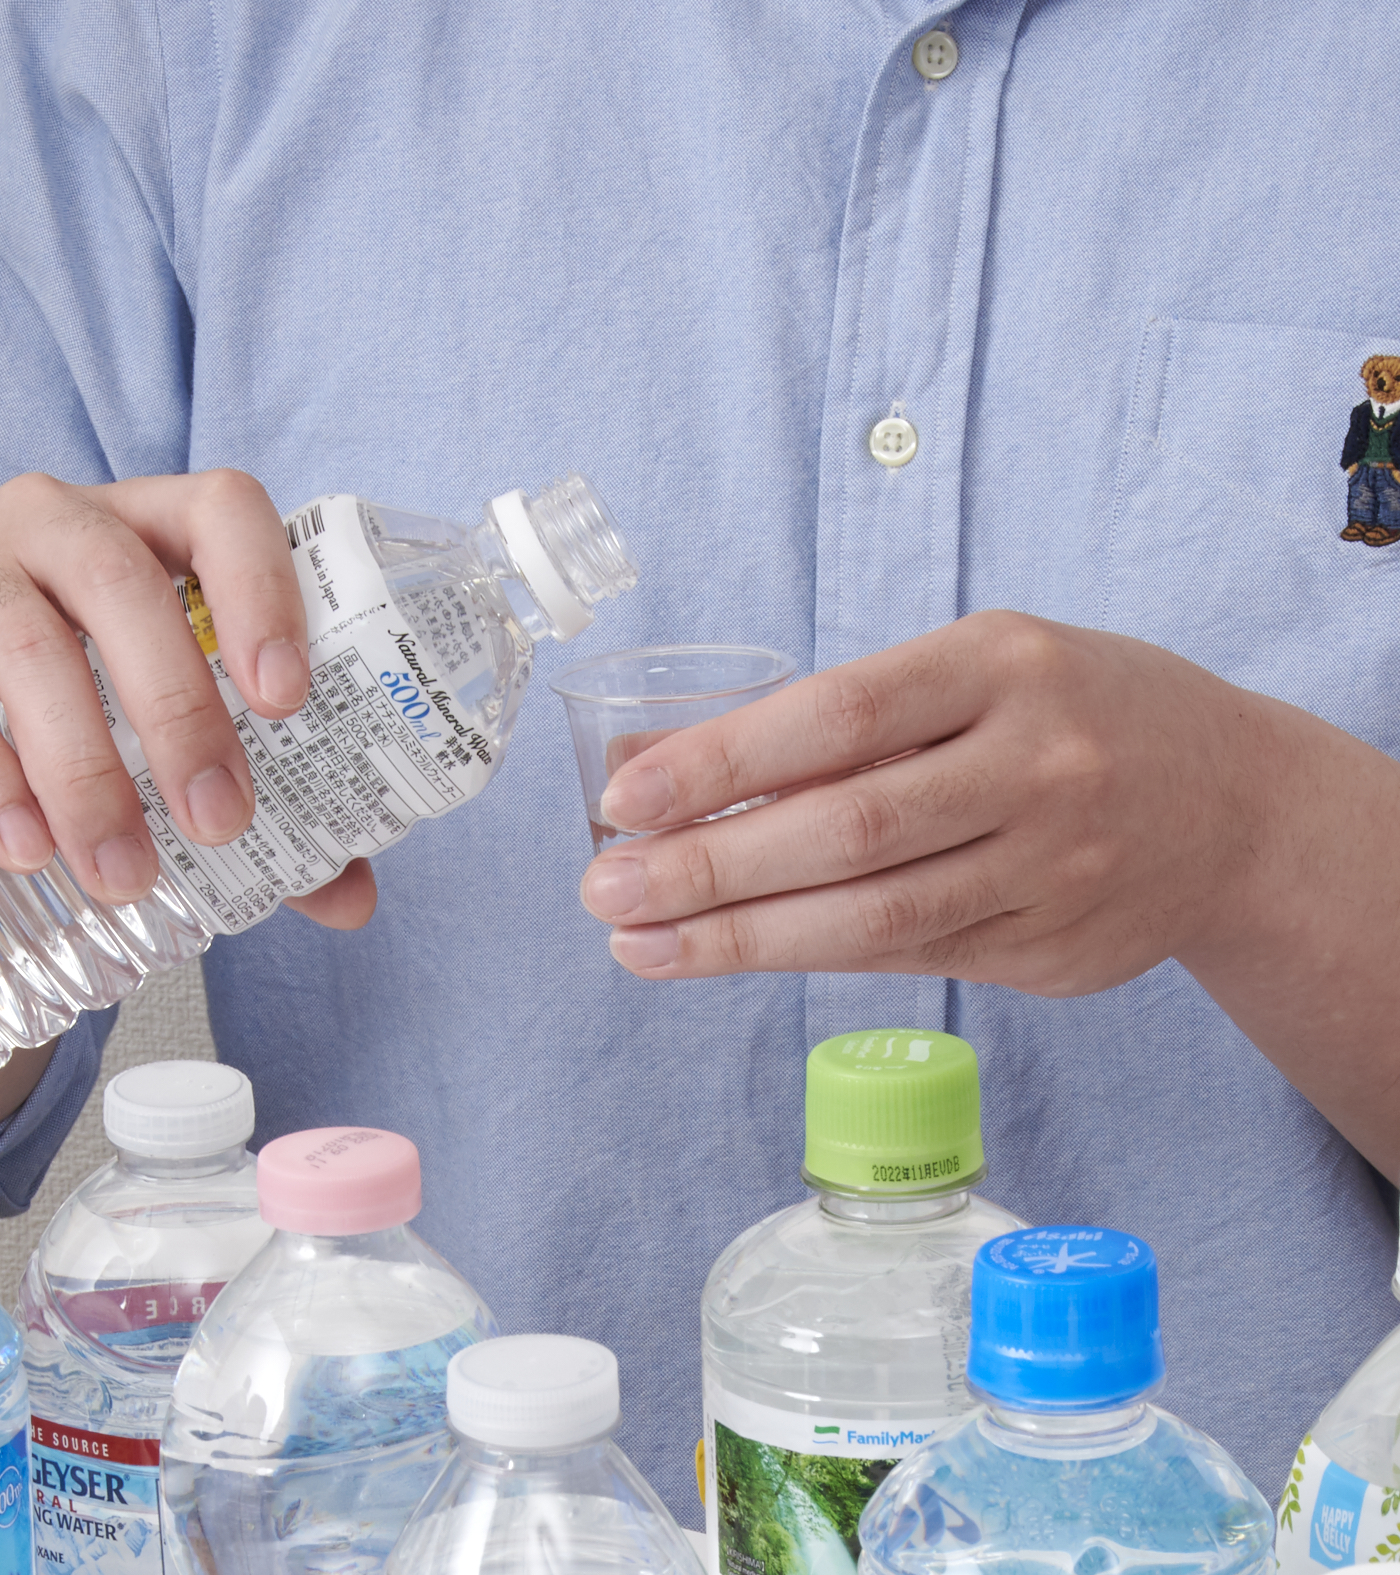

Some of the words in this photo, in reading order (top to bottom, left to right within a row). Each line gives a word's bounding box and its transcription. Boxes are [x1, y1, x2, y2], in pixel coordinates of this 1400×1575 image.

[306, 543, 326, 572] Made
[313, 565, 333, 583] in
[319, 578, 343, 612] Japan
[311, 669, 351, 715] 内容量
[325, 660, 366, 708] 原材料名
[359, 708, 395, 749] 水(鉱水)
[378, 666, 439, 742] 500ml
[389, 623, 438, 689] Natural
[426, 683, 473, 737] Mineral
[467, 729, 495, 766] Water
[330, 724, 391, 798] ボトル側面に記載
[373, 699, 458, 803] ナチュラルミネラルウォーター
[434, 747, 459, 773] 軟水
[443, 734, 473, 768] 非加熱
[231, 718, 271, 764] 採水地
[263, 763, 320, 832] 岐阜県関市洞戸
[289, 749, 363, 840] 奥長良川名水株式会社
[304, 741, 381, 836] 避けて保存してください。
[316, 733, 401, 837] 直射日光、高温多湿の場所を
[277, 755, 358, 853] 岐阜県関市洞戸栗原291
[157, 827, 176, 848] 7.4
[173, 849, 195, 873] 硬度
[294, 862, 317, 887] 0kcal
[53, 1431, 110, 1458] SOURCE
[56, 1511, 118, 1542] WATER
[1321, 1504, 1354, 1531] HAPPY
[1322, 1525, 1352, 1554] BELLY
